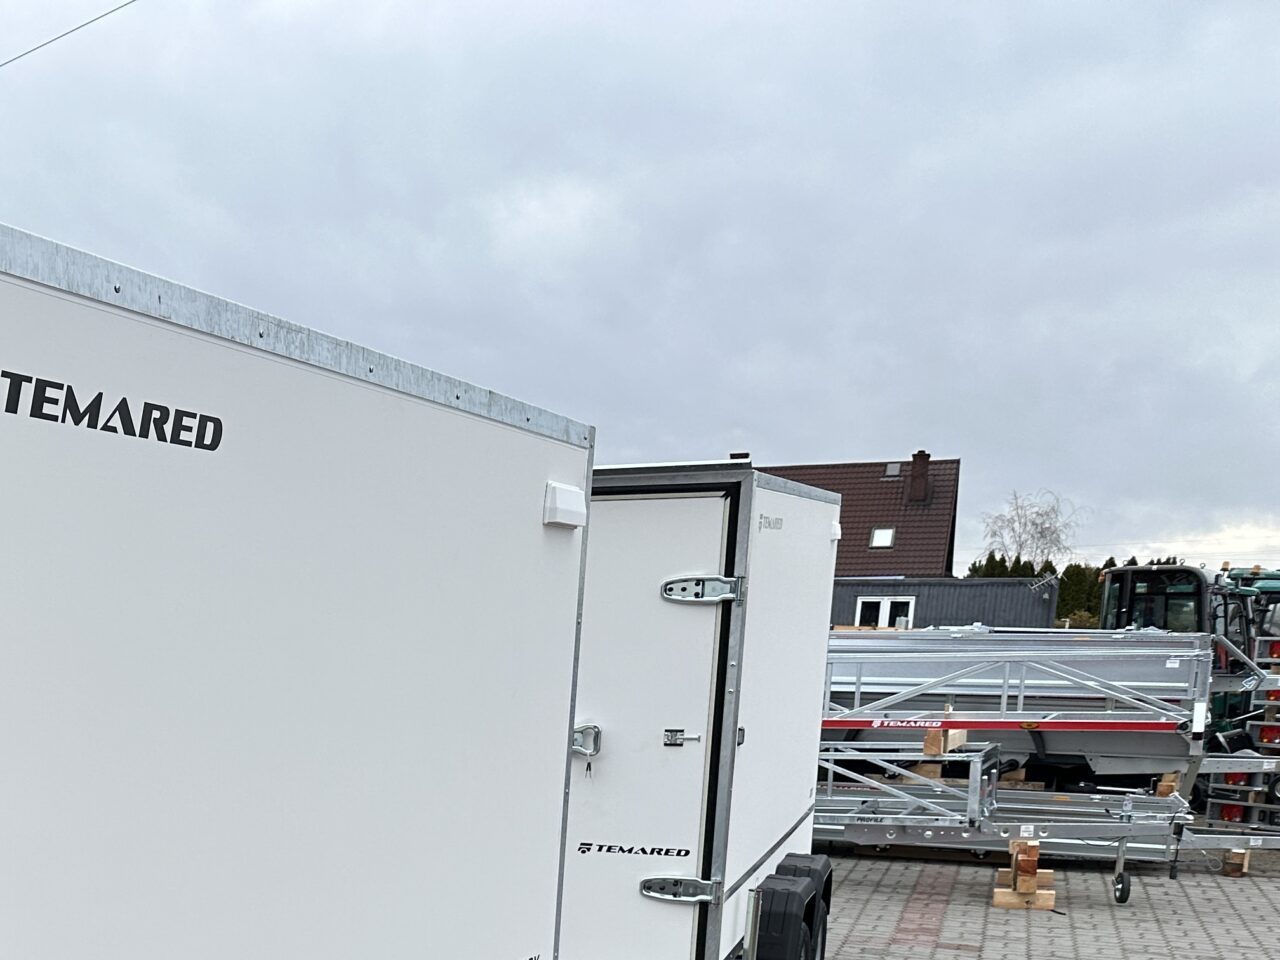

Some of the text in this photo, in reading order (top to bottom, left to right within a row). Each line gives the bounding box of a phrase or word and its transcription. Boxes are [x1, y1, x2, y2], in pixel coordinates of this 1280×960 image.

[1, 370, 223, 452] TEMARED
[883, 720, 943, 728] TEMARED
[856, 816, 884, 824] PROFILE
[595, 844, 691, 857] TEMARED
